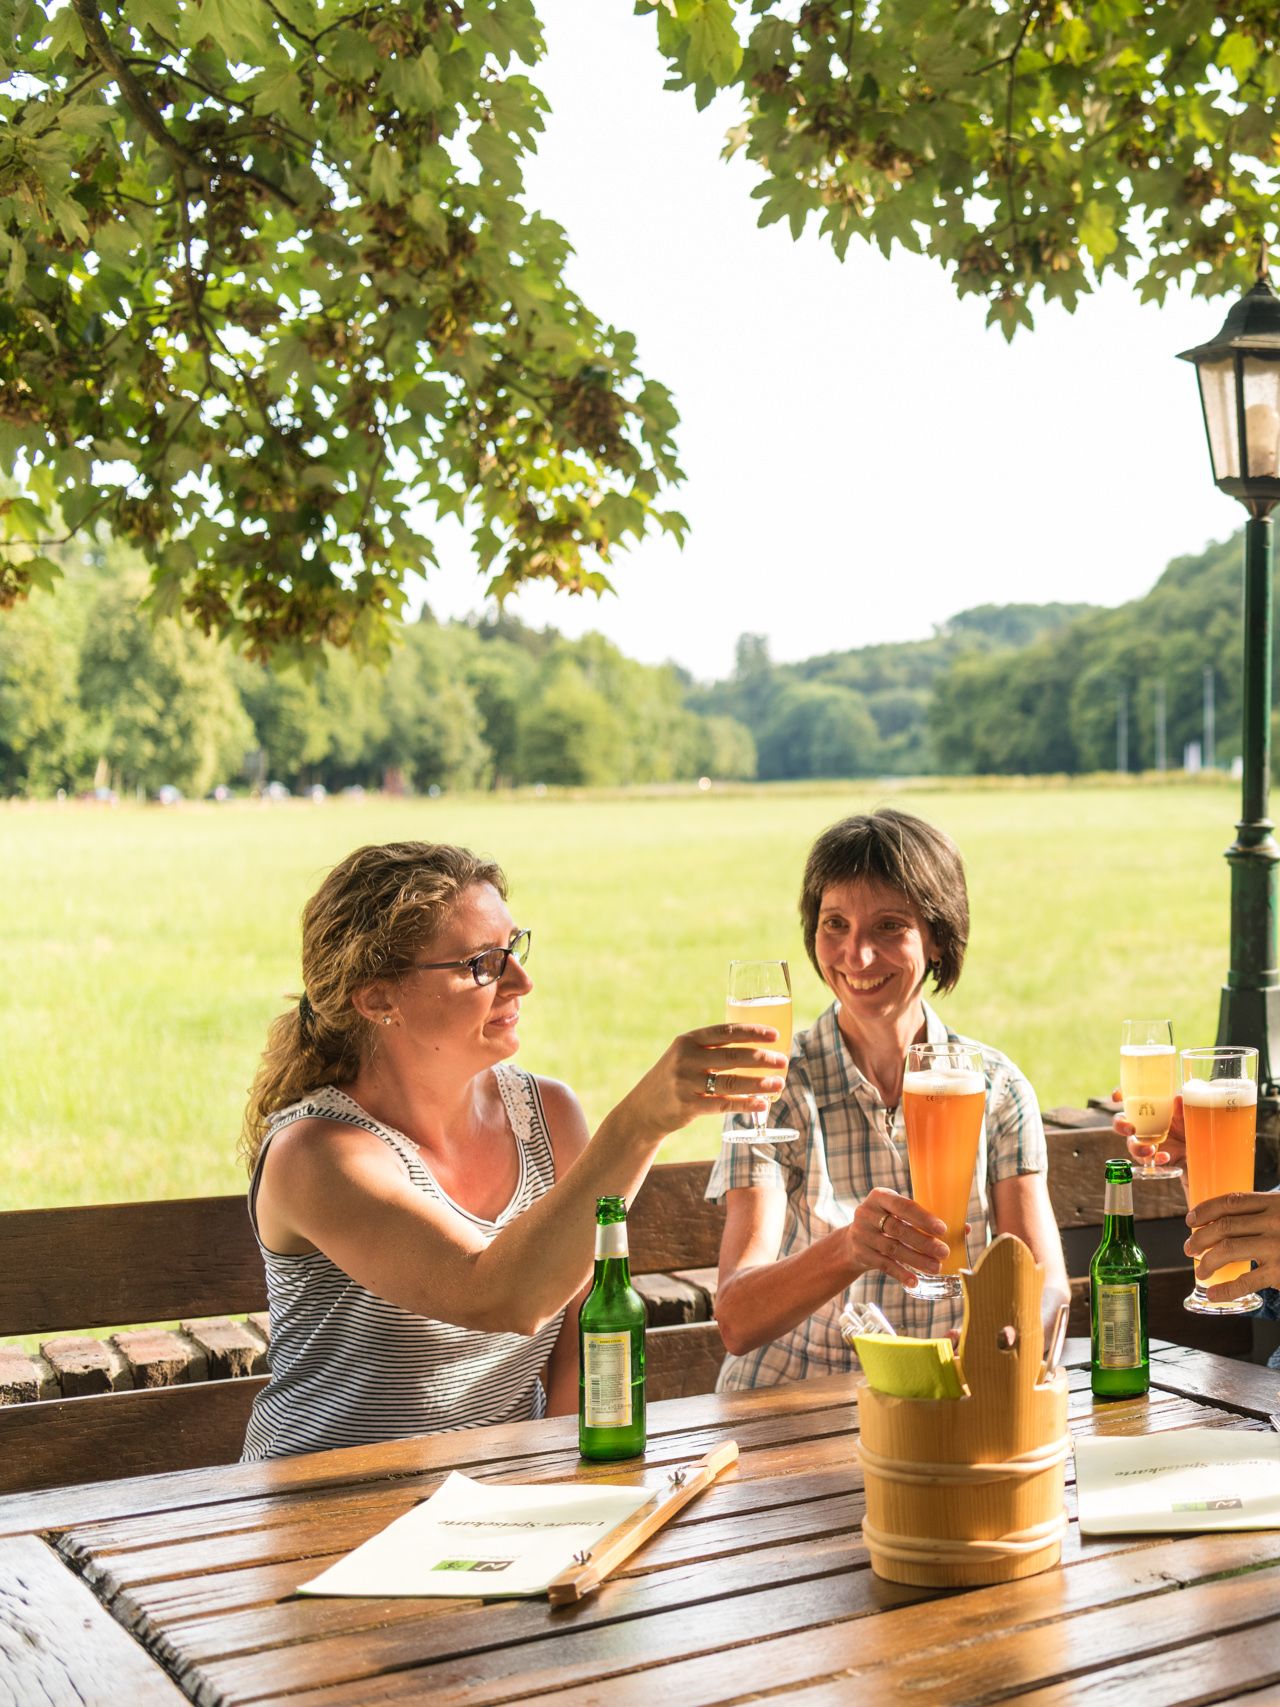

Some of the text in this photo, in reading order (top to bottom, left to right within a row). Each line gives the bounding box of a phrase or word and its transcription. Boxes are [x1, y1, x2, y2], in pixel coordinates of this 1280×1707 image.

[1114, 1462, 1210, 1476] Speisekarte
[437, 1519, 605, 1528] Unsere Speisekarte
